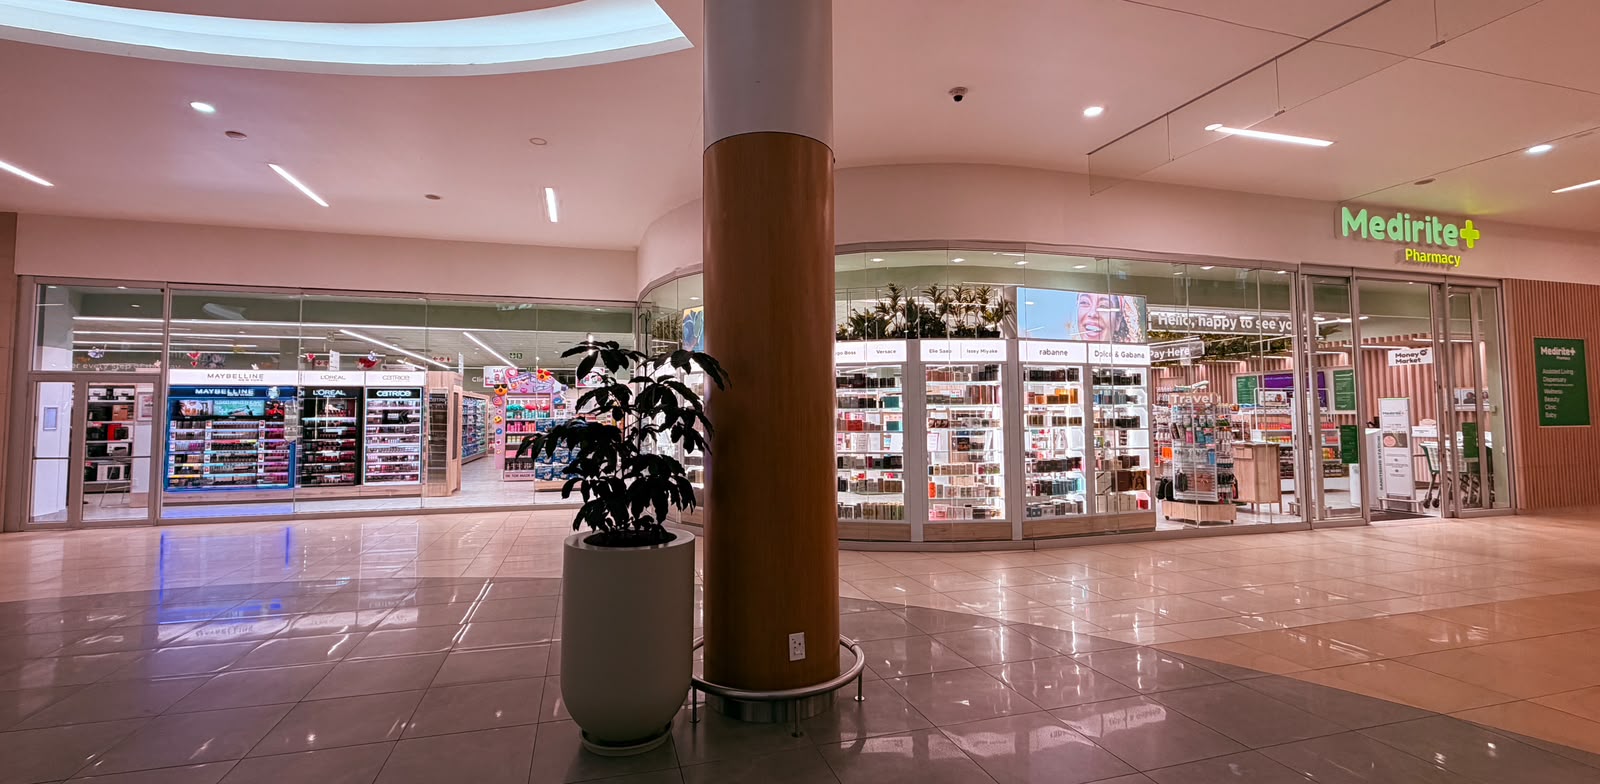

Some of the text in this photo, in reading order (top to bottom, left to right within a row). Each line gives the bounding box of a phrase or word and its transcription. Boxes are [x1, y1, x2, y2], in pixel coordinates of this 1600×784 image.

[1341, 206, 1480, 248] Medirite+
[1405, 247, 1460, 267] Pharmacy
[1158, 313, 1195, 328] Hello,
[1199, 314, 1237, 331] happy
[1240, 316, 1253, 329] to
[1256, 318, 1276, 330] see
[1039, 348, 1068, 357] rabanne
[1094, 350, 1112, 358] Dolce
[1150, 346, 1190, 360] Pay Here
[1171, 393, 1214, 405] Travel
